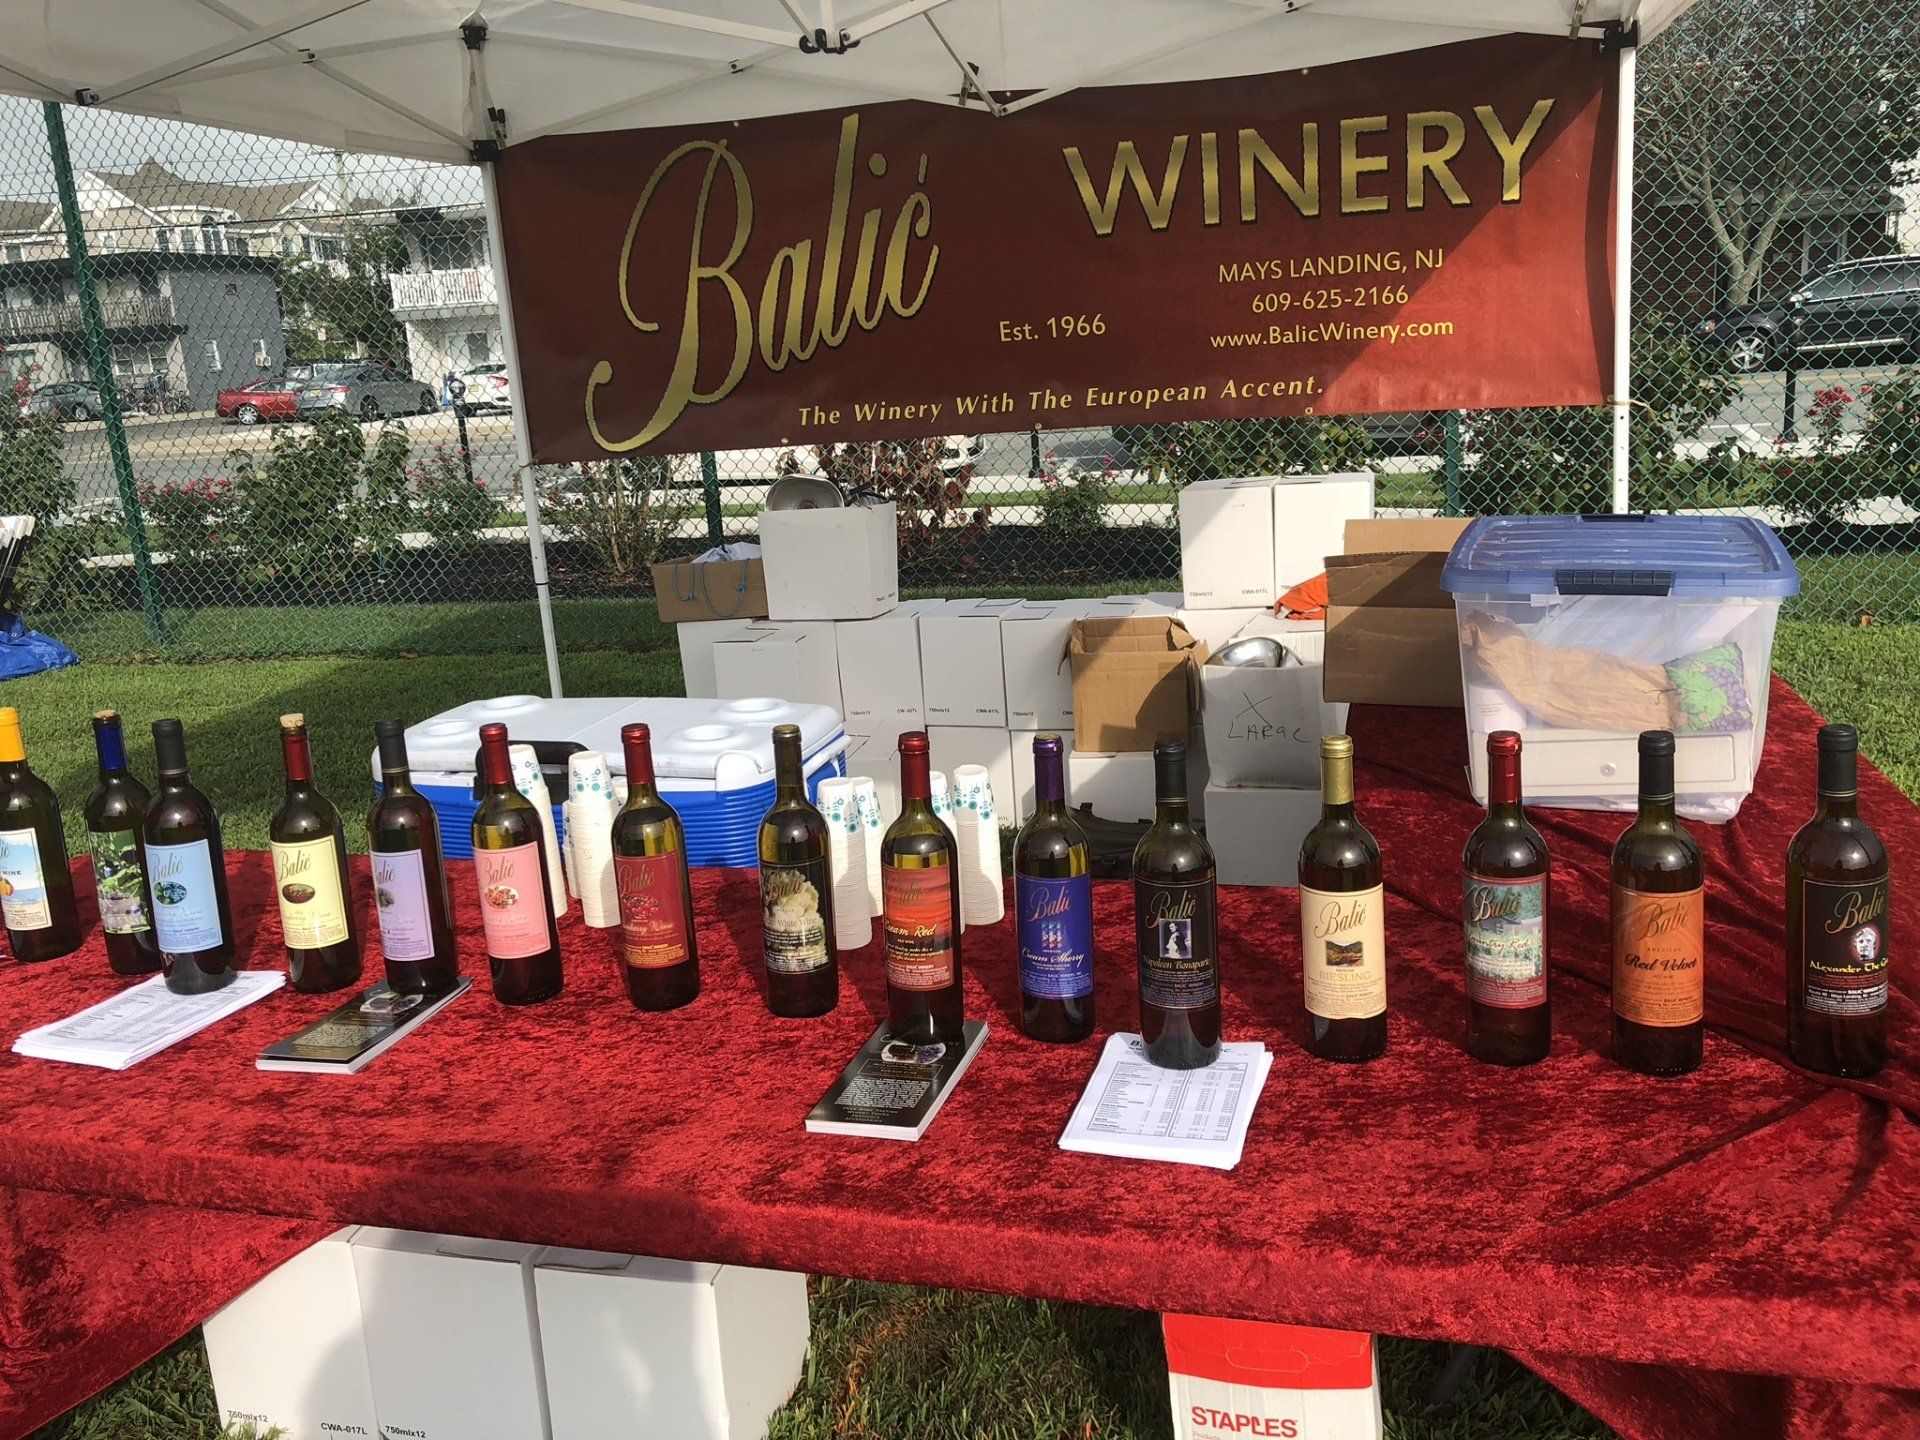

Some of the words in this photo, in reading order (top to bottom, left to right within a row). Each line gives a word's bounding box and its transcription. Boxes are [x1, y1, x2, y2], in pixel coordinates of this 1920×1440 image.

[1062, 98, 1556, 238] WINERY
[1219, 260, 1283, 283] MAYS
[1290, 252, 1408, 279] LANDING,
[1415, 248, 1444, 269] NJ
[586, 113, 940, 452] Balić
[1252, 285, 1409, 313] 609-625-2166
[999, 321, 1039, 343] Est.
[1046, 315, 1107, 339] 1966
[1210, 321, 1454, 348] www.BalicWinery.com
[798, 405, 841, 426] The
[854, 401, 942, 424] Winery
[956, 392, 1015, 416] With
[1029, 389, 1073, 410] The
[1086, 385, 1208, 409] European
[1221, 376, 1324, 399] Accent.
[914, 923, 938, 938] Red
[1624, 953, 1659, 971] Red
[1660, 957, 1698, 971] Velvet
[1809, 960, 1863, 974] Alexander
[1864, 961, 1881, 972] The
[1319, 971, 1372, 982] RIESLING
[227, 1409, 268, 1423] 750mlx12
[320, 1422, 368, 1436] CWA-017L
[1191, 1405, 1298, 1438] STAPLES
[385, 1425, 427, 1439] 750mlx12
